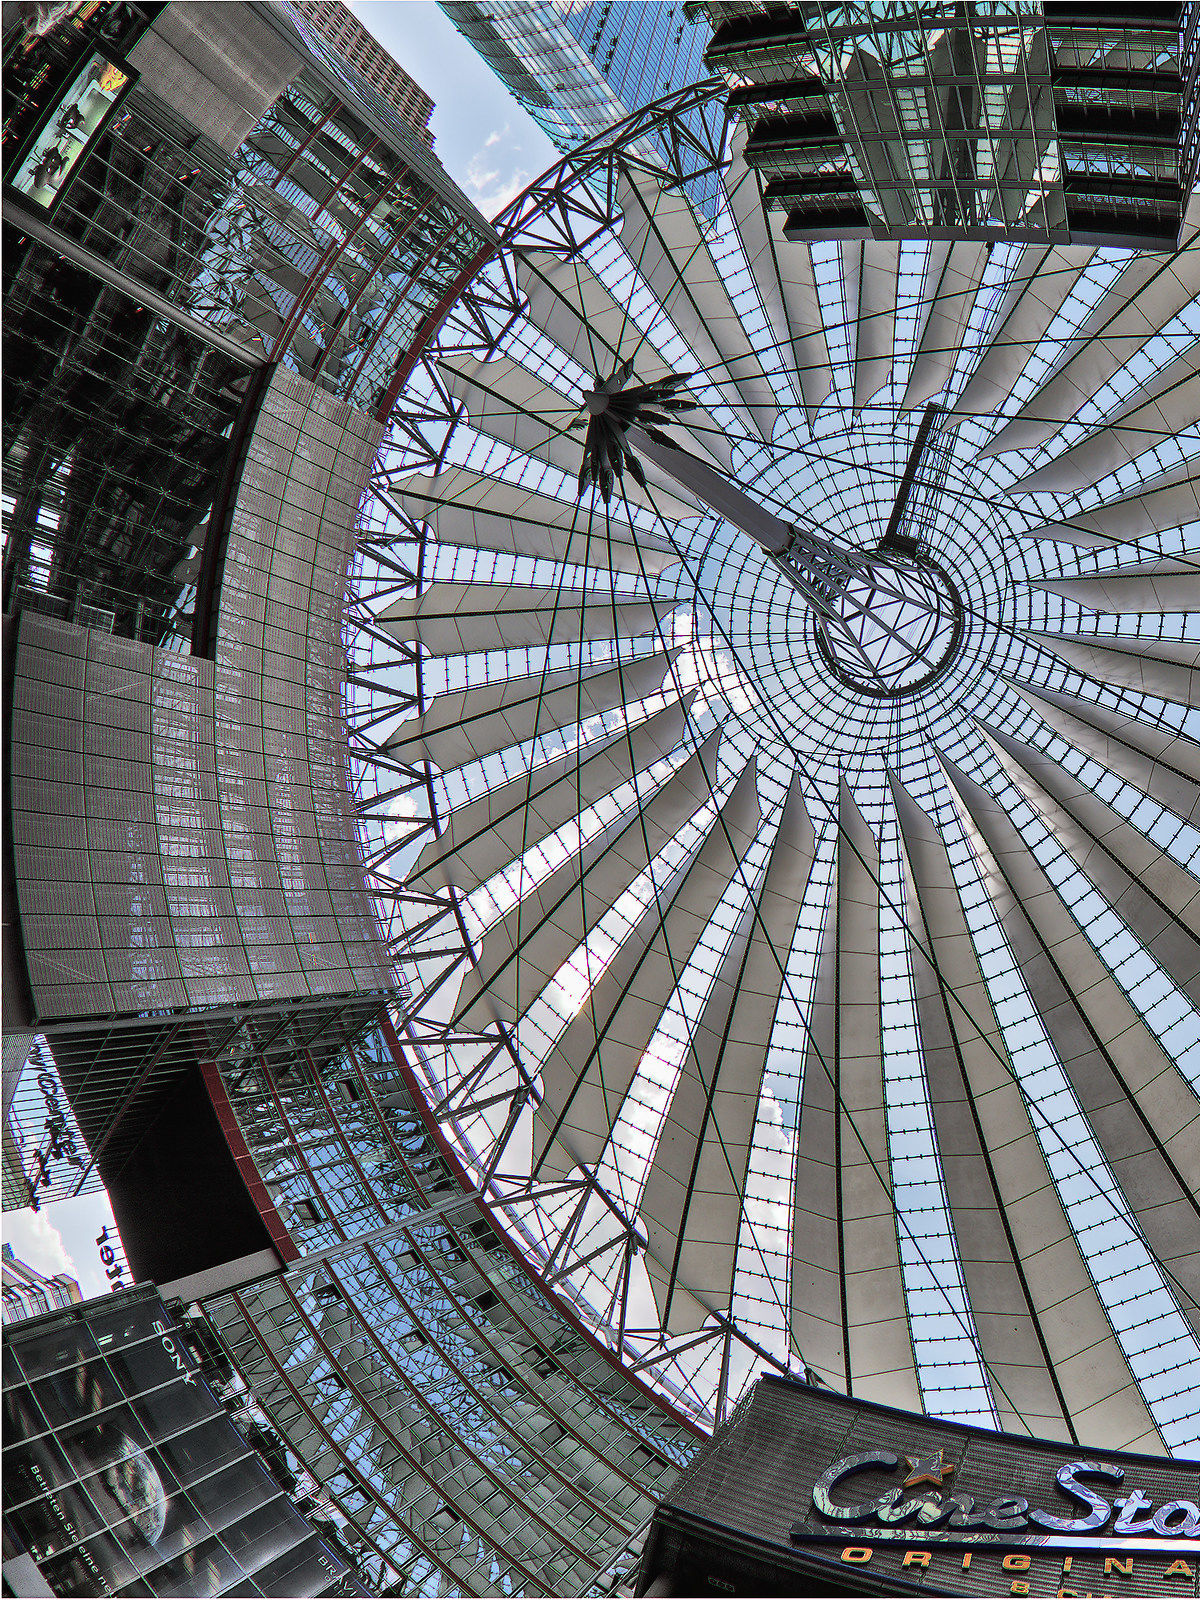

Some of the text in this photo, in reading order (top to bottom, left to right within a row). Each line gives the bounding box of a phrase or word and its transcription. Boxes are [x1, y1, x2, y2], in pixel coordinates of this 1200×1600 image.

[151, 1320, 198, 1387] SONY
[30, 1464, 66, 1521] Betreten
[63, 1522, 80, 1543] Sie
[78, 1545, 100, 1574] eine
